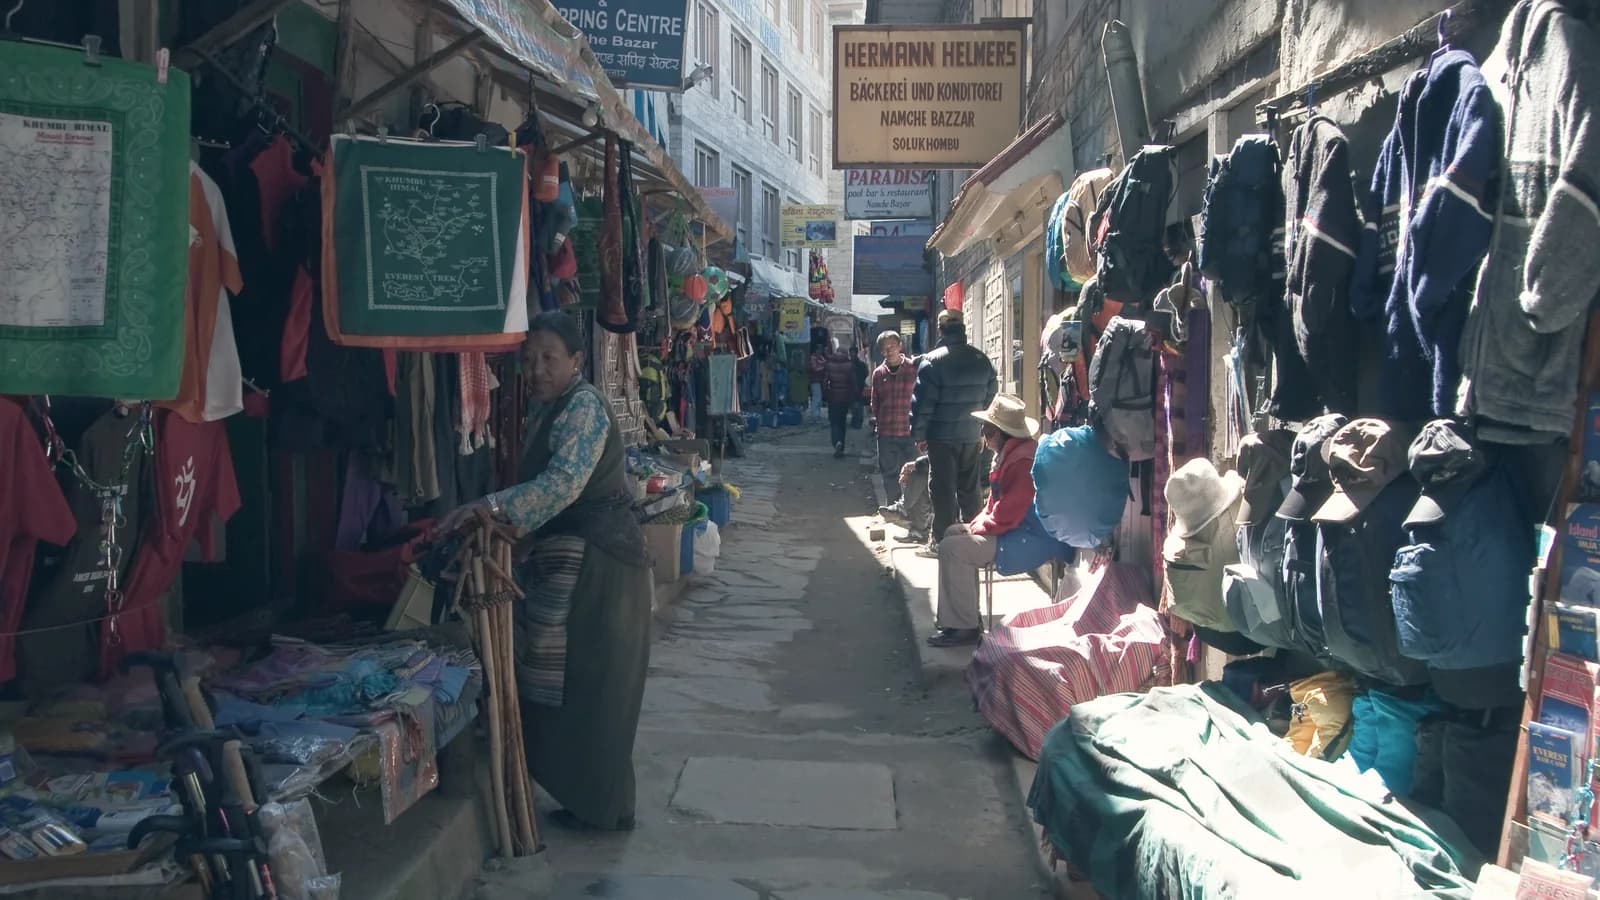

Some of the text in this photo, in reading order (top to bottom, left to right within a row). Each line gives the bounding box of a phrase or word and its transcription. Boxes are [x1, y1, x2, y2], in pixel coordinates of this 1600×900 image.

[615, 9, 682, 36] CENTRE
[585, 34, 658, 49] he Bazar
[844, 41, 1017, 68] HERMANN HELMERS
[911, 82, 935, 101] UND
[936, 82, 1003, 102] KONDITOREI
[880, 110, 975, 128] NAMCHE BAZZAR
[892, 137, 960, 151] SOLUKHOMBU
[385, 176, 425, 185] KHUMBU
[848, 169, 929, 186] PARADISE
[385, 272, 457, 282] EVEREST TREK
[1568, 522, 1598, 538] Island
[1533, 745, 1569, 762] EVEREST
